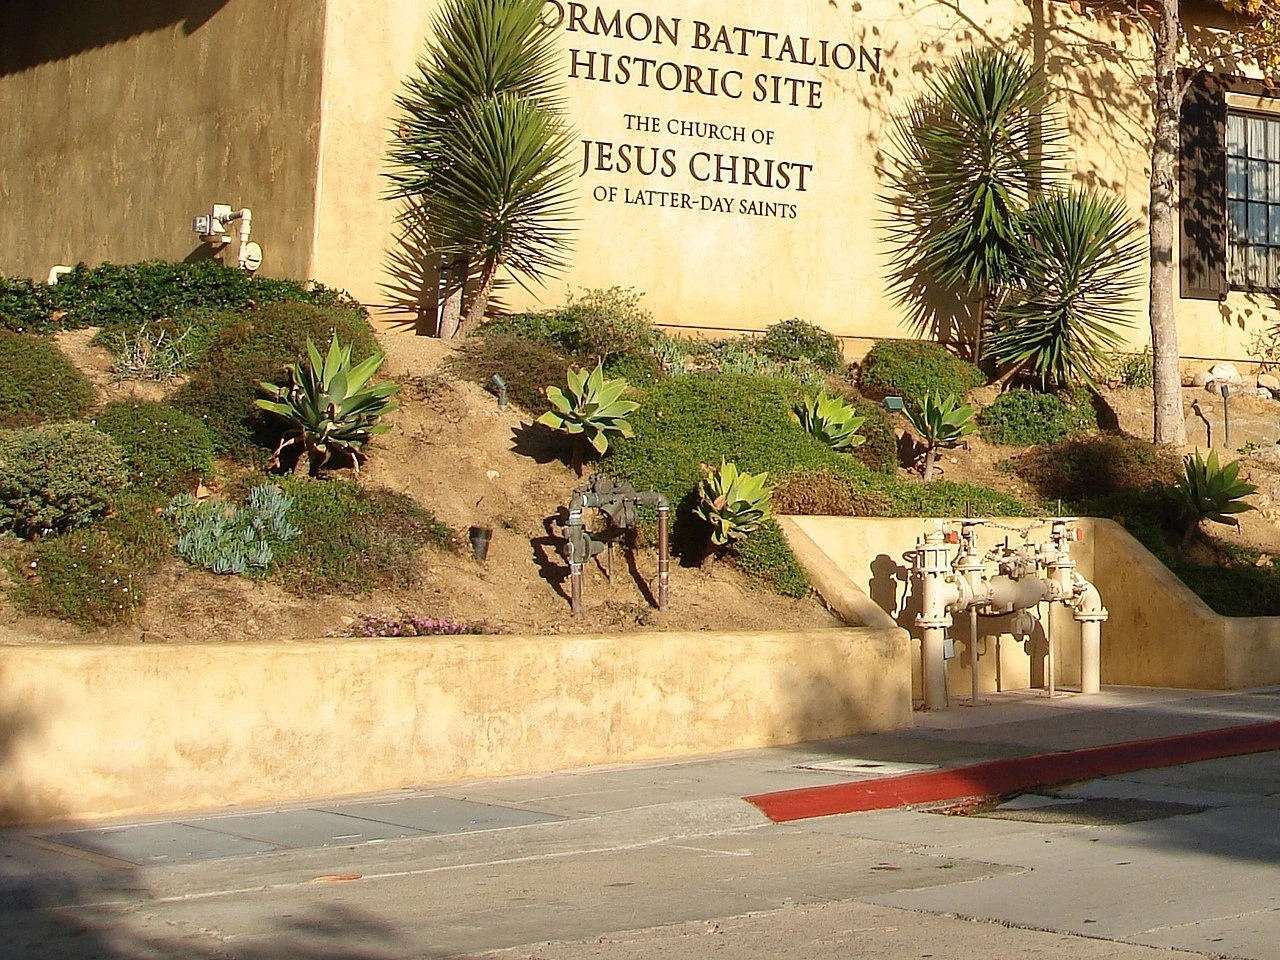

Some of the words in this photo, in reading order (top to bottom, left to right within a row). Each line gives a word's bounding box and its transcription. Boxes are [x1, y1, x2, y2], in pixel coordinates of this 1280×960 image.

[690, 20, 883, 74] BATTALION
[567, 48, 743, 99] HISTORIC
[752, 74, 823, 109] SITE
[623, 113, 661, 134] THE
[666, 118, 746, 144] CHURCH
[751, 128, 775, 146] OF
[578, 139, 677, 178] JESUS
[688, 151, 813, 192] CHRIST
[593, 185, 618, 203] OF
[624, 187, 735, 215] LATTER-DAY
[738, 199, 798, 220] SAINTS
